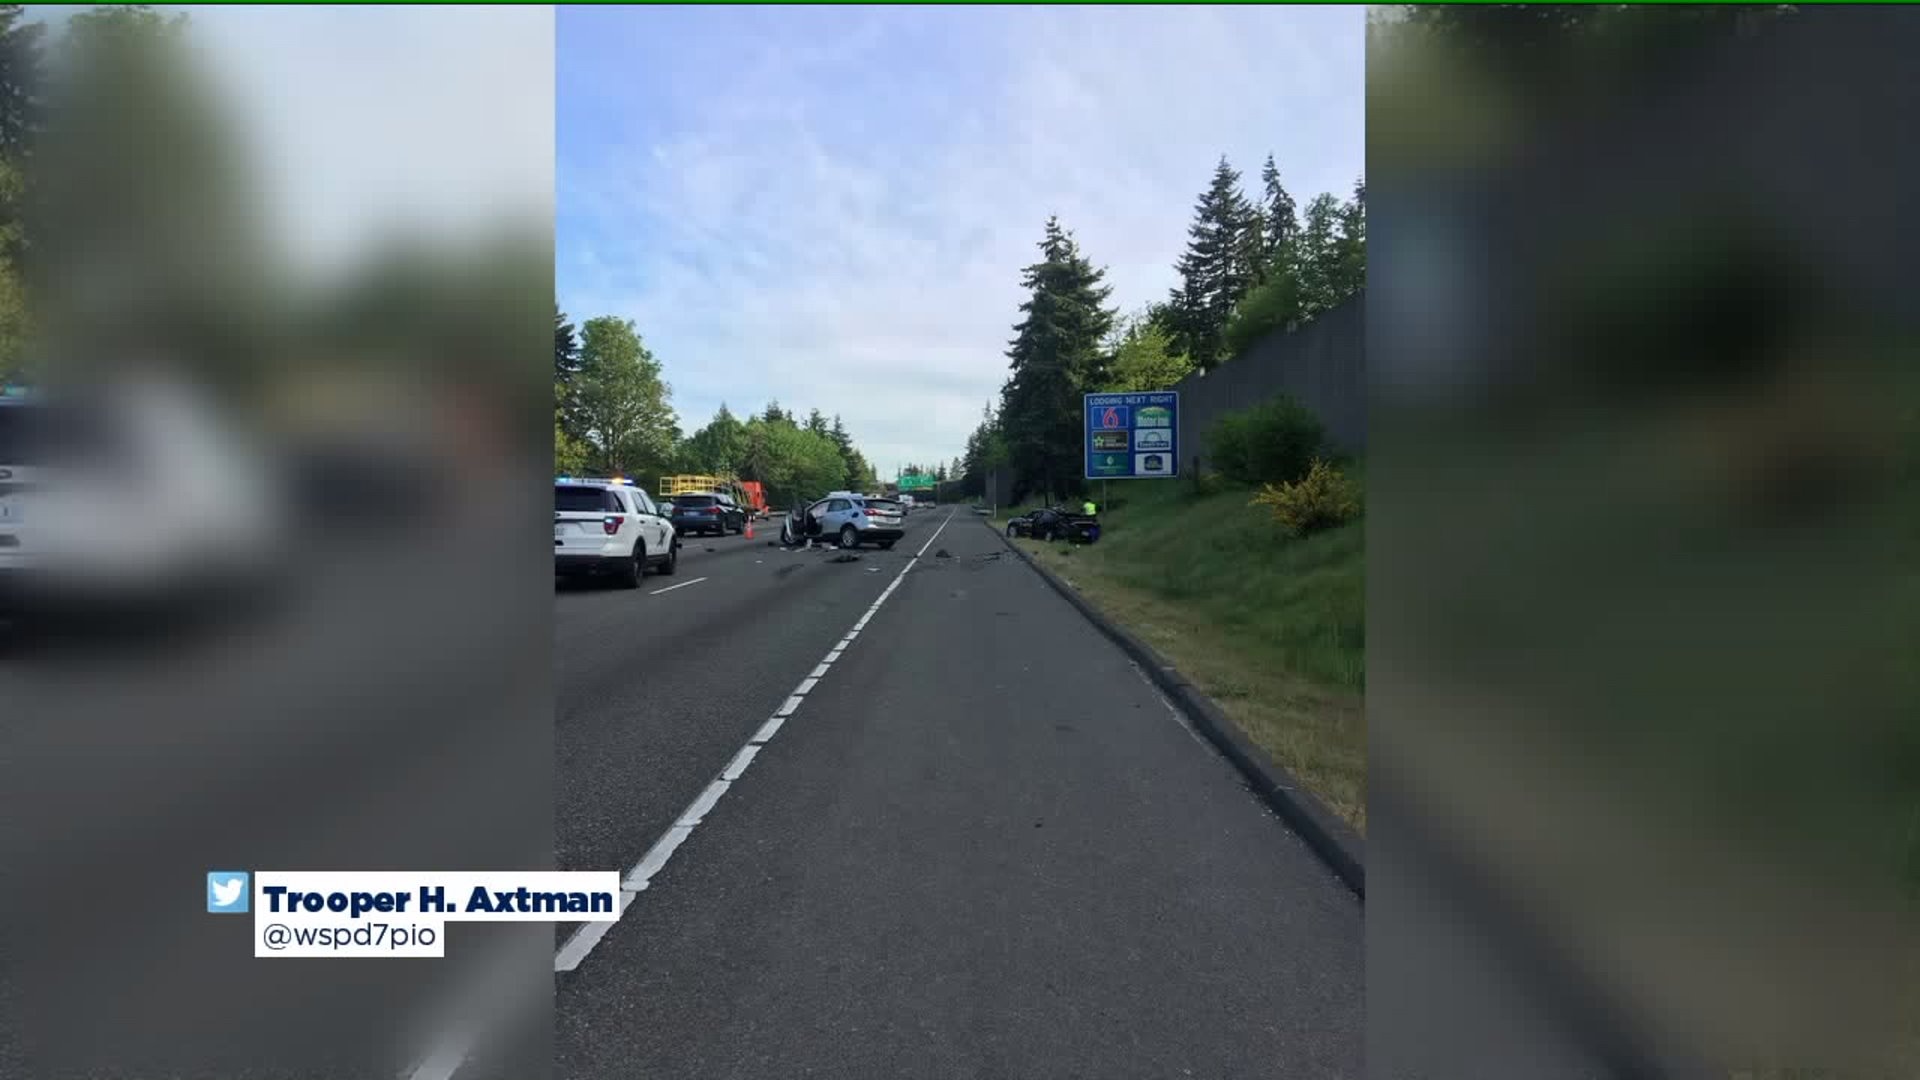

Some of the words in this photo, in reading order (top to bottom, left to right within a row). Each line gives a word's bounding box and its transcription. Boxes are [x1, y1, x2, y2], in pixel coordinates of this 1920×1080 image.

[1089, 397, 1123, 405] LODGING
[1126, 396, 1145, 404] NEXT
[1150, 395, 1173, 403] RIGHT
[1103, 407, 1119, 428] 6
